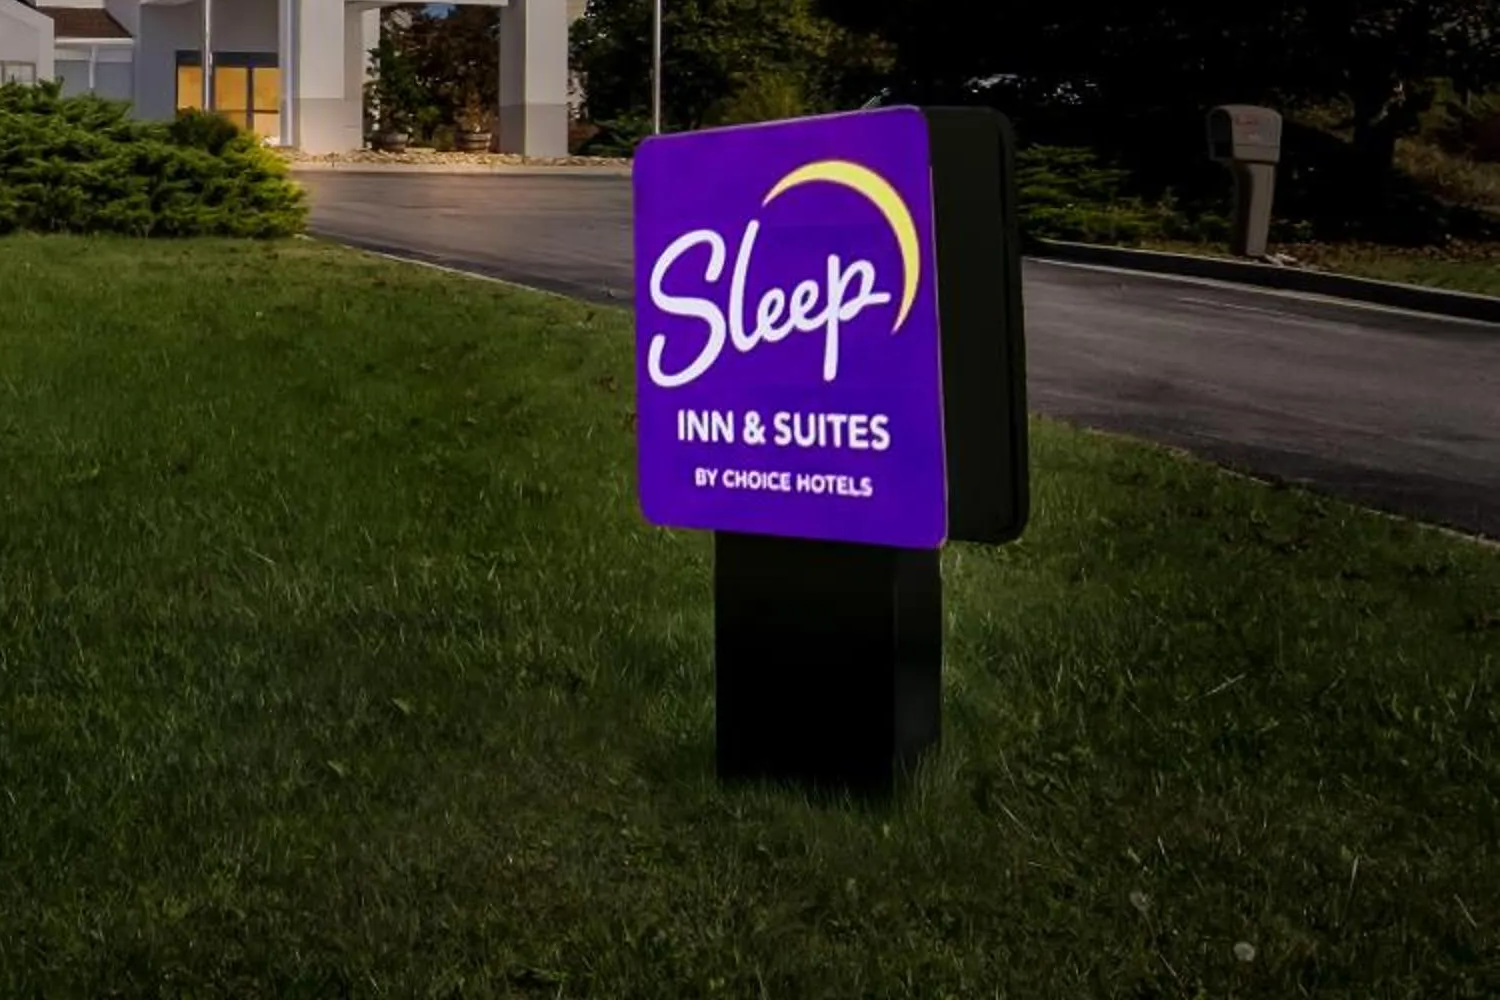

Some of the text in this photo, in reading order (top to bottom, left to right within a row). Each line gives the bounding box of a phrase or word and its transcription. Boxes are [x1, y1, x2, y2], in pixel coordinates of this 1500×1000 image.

[647, 219, 891, 387] Sleep
[677, 409, 891, 451] INN & SUITES
[695, 467, 873, 497] BY CHOICE HOTELS
